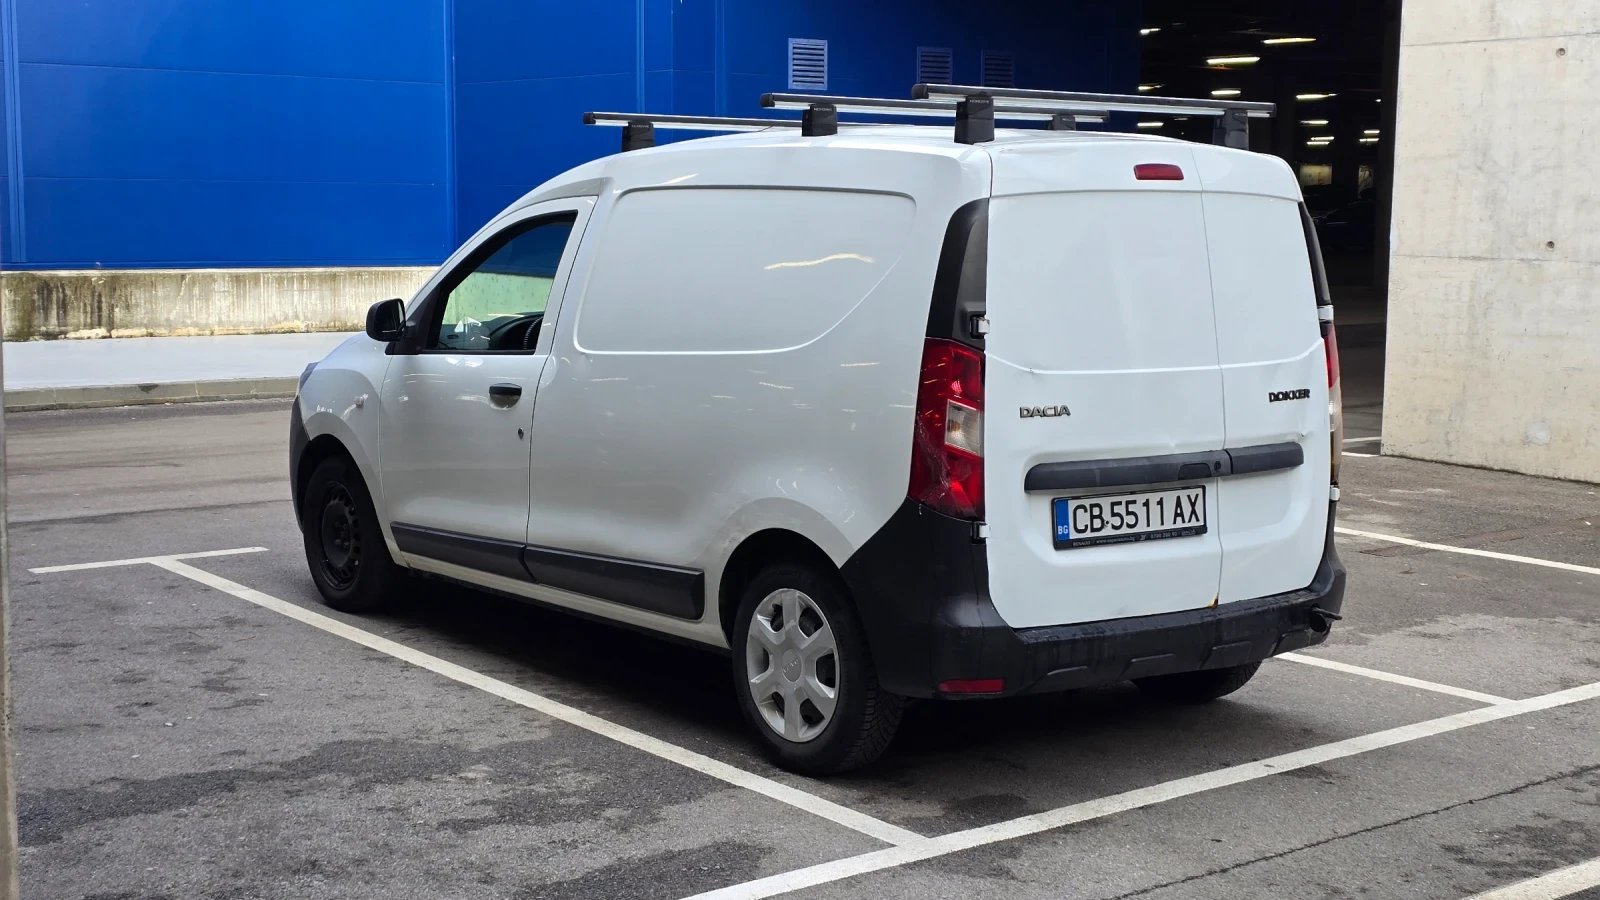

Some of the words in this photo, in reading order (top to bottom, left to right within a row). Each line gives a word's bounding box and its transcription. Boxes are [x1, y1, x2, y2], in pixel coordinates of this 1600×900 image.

[1269, 388, 1310, 402] DOKKER
[1019, 405, 1071, 418] DACIA
[1072, 502, 1105, 534] CB
[1110, 497, 1165, 531] 5511
[1172, 493, 1200, 525] AX
[1057, 525, 1069, 534] BG
